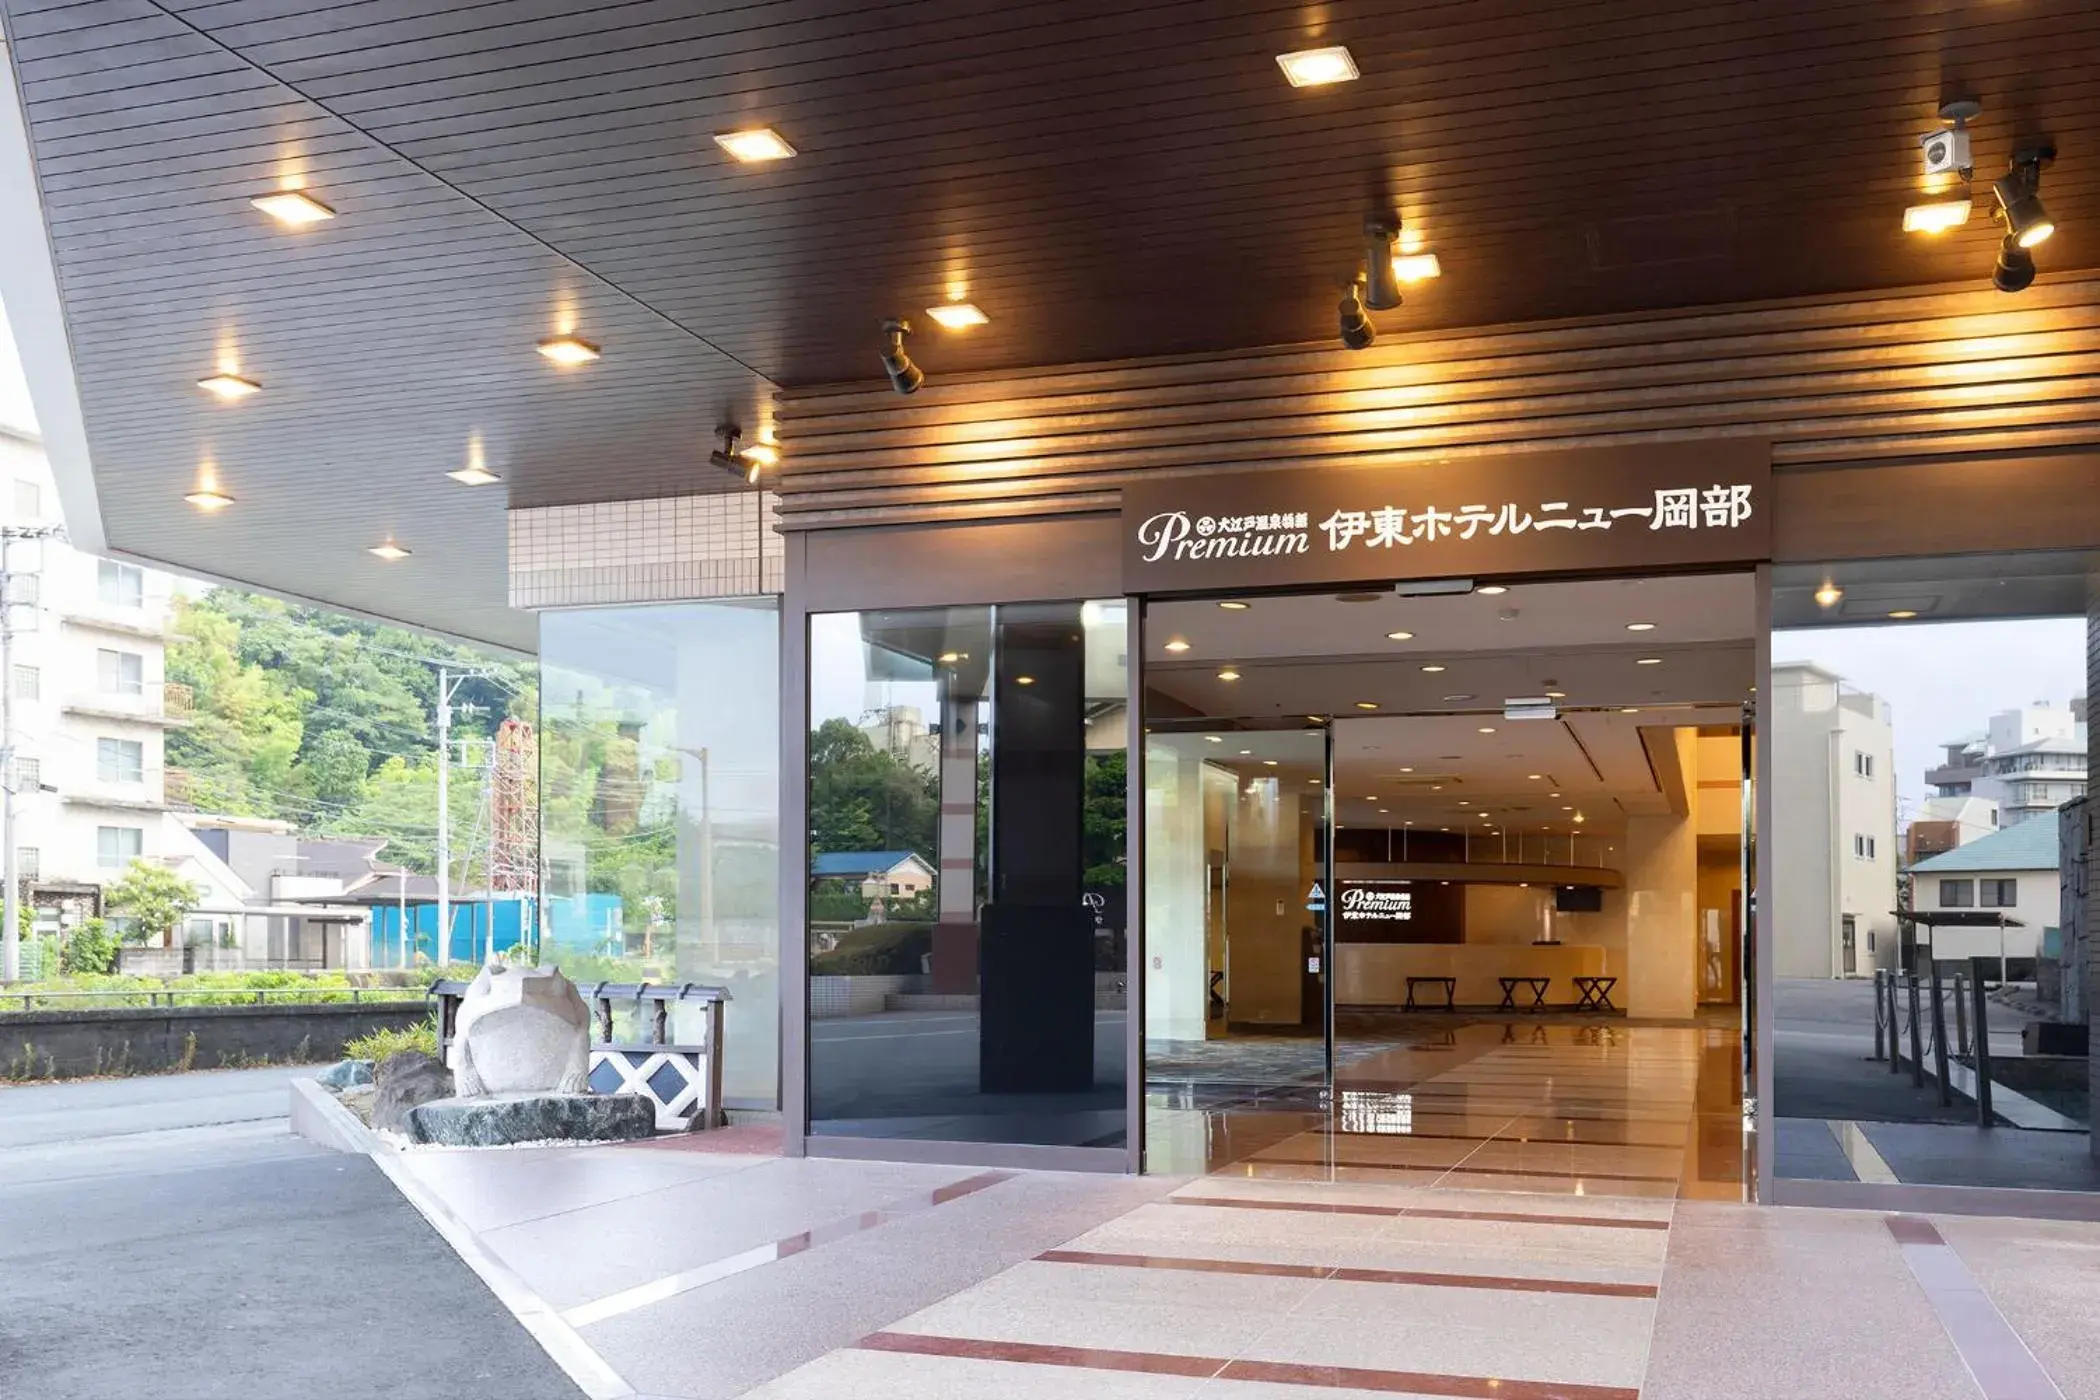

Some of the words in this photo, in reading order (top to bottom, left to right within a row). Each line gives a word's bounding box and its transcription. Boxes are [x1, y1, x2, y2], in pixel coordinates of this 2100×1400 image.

[1137, 510, 1310, 562] Premium
[1318, 484, 1752, 551] 伊東ホテルニュー岡部
[1341, 888, 1411, 910] Premium
